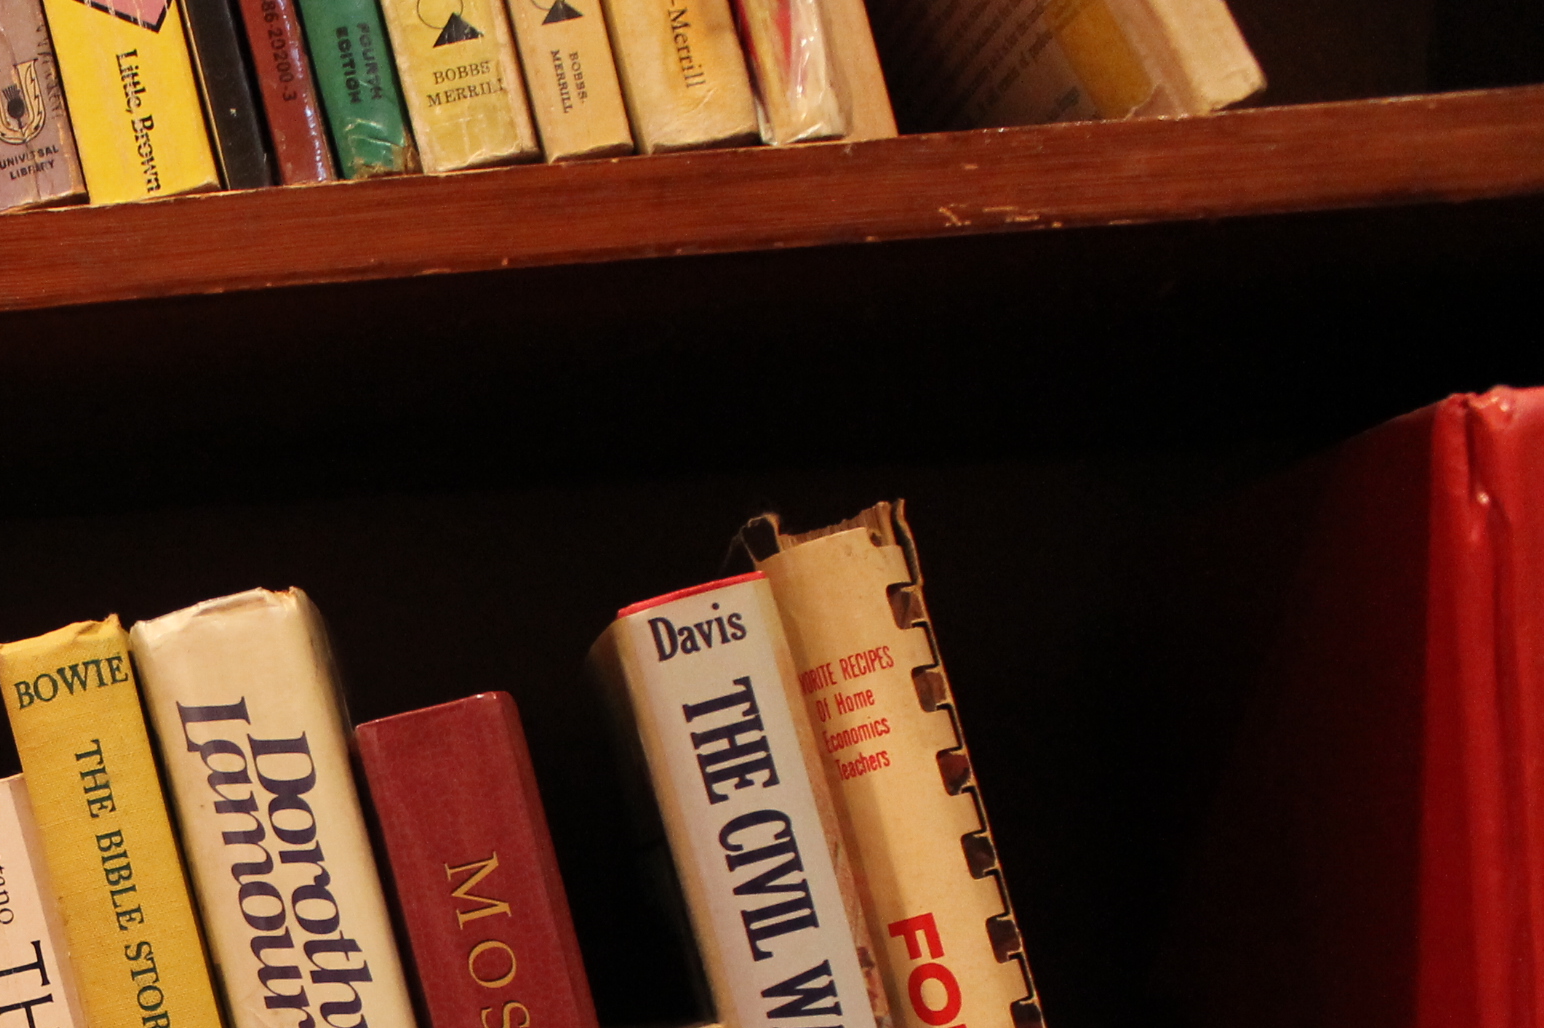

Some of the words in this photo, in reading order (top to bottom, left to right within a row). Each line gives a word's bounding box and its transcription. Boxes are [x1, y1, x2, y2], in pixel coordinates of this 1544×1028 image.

[432, 59, 492, 86] BOBBS
[550, 49, 574, 114] MERRILL
[115, 49, 147, 113] Little,
[131, 114, 162, 194] Brown
[648, 602, 748, 663] Davis
[838, 644, 895, 681] RECIPES
[12, 655, 129, 711] BOWIE
[834, 688, 875, 716] Home
[682, 675, 781, 806] THE
[822, 717, 891, 754] Economics
[834, 750, 892, 781] Teachers
[74, 739, 117, 820] THE
[94, 828, 146, 932] BIBLE
[717, 807, 820, 963] CIVIL
